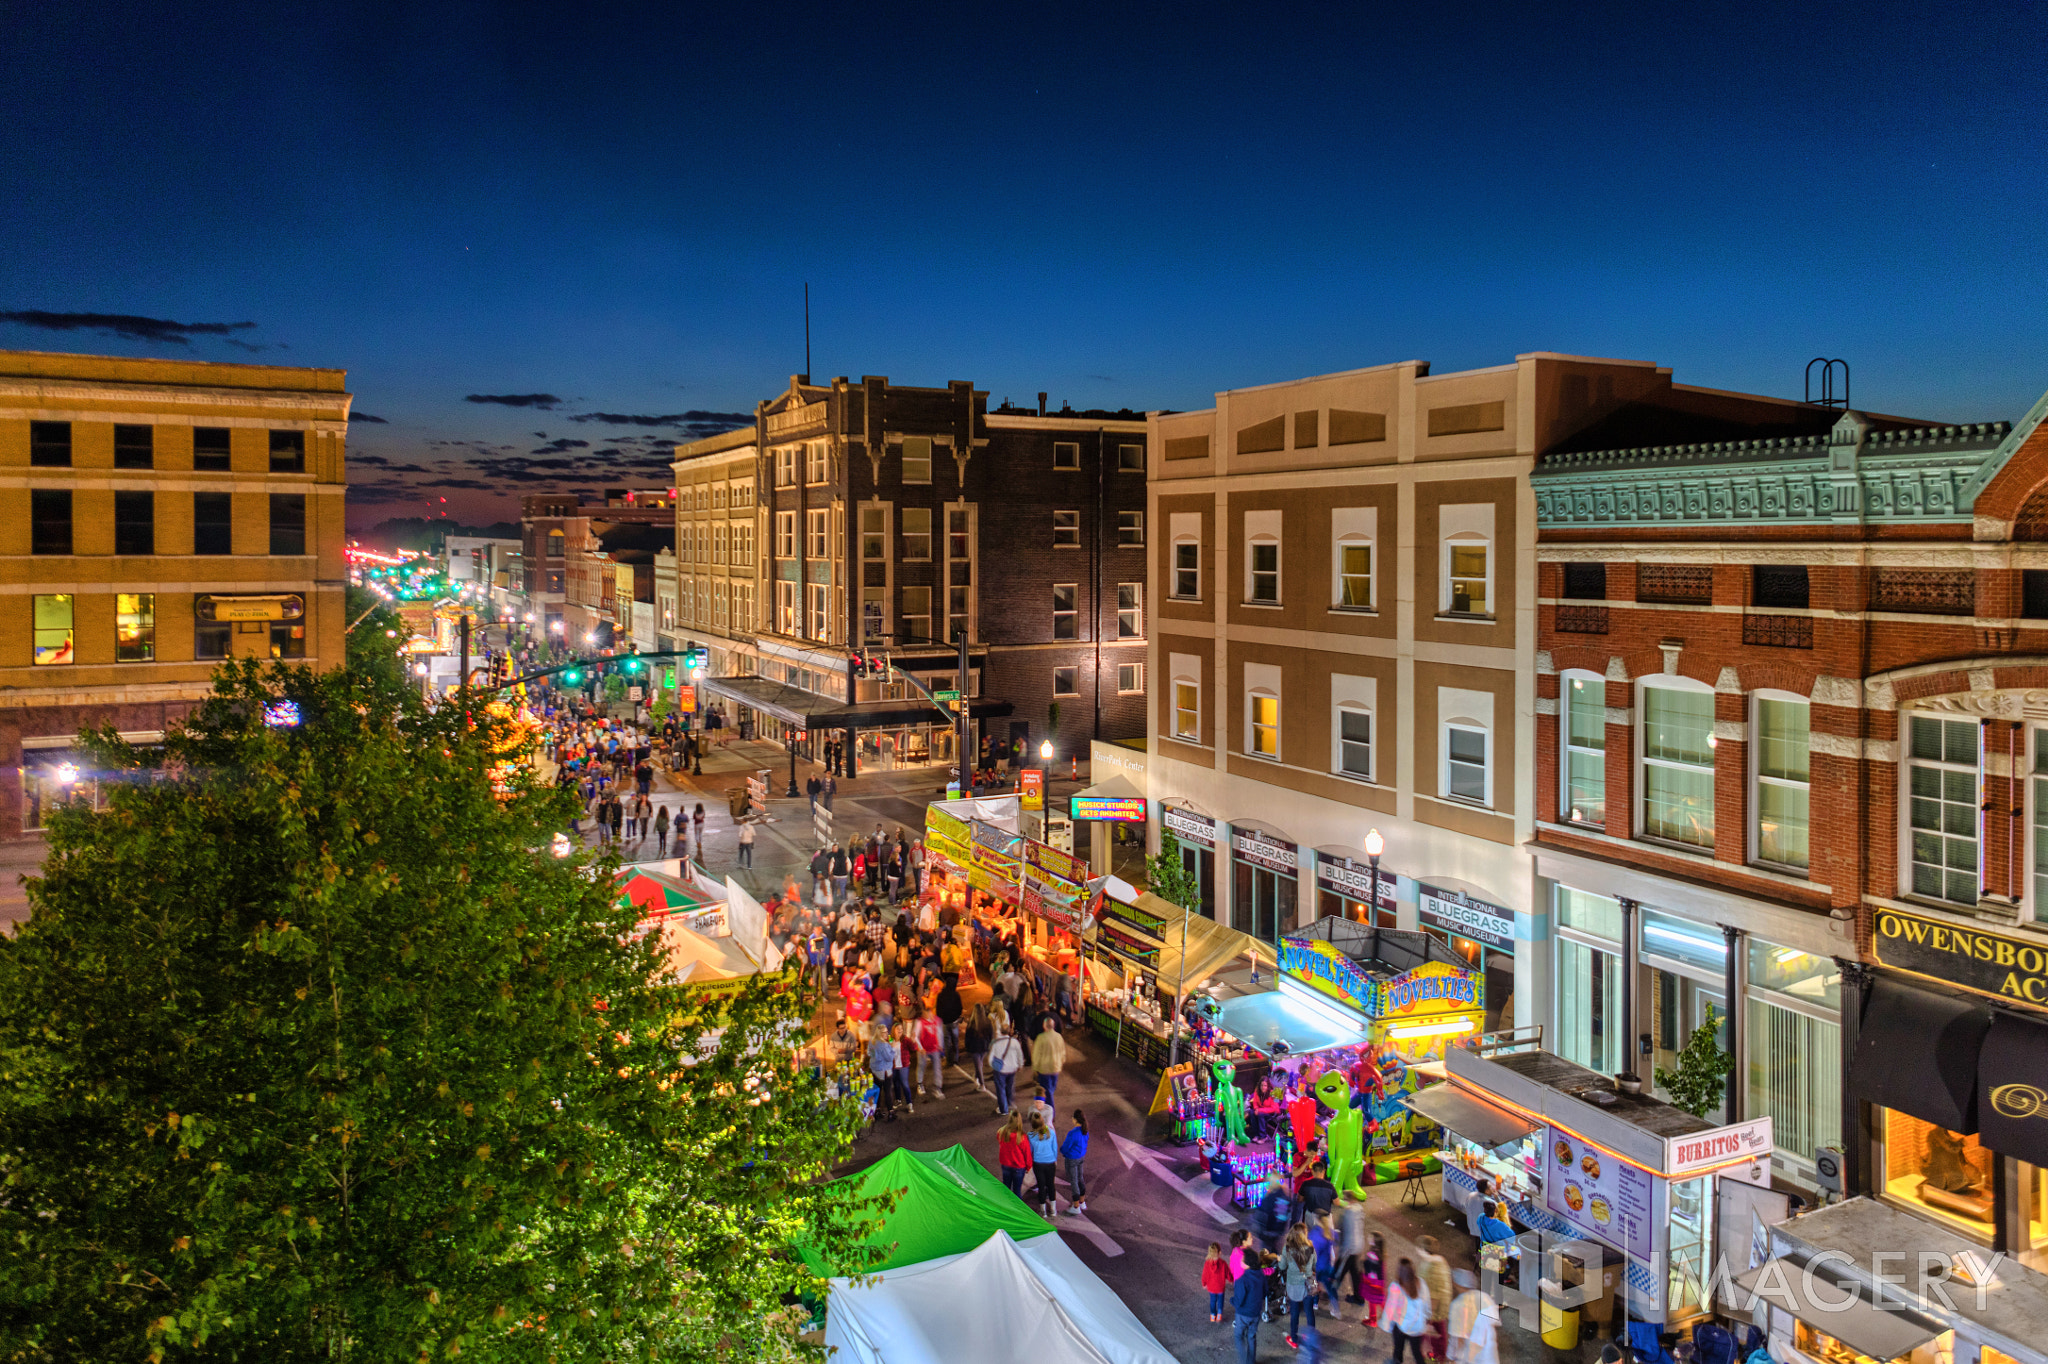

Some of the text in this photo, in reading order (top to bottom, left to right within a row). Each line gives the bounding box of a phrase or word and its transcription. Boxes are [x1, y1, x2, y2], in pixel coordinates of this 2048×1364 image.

[1124, 759, 1144, 772] Center
[1029, 788, 1036, 797] 5
[1078, 800, 1139, 809] MUSICK STUDIOS
[1080, 809, 1136, 818] GETS ANIMATED
[1167, 814, 1215, 839] BLUEGRASS
[1173, 808, 1208, 825] INTERNATIONAL
[1187, 832, 1210, 846] MUSEUM
[1239, 838, 1295, 865] BLUEGRASS
[1244, 853, 1289, 873] MUSIC MUSEUM
[1033, 868, 1050, 882] DEEP
[1332, 882, 1384, 906] MUSIC MUSEM
[1428, 899, 1509, 935] BLUEGRASS
[1437, 917, 1500, 945] MUSIC MUSEUM
[1285, 946, 1371, 1007] NOVELTIES
[695, 982, 736, 992] Delicious
[1387, 976, 1476, 1013] NOVELTIES
[2000, 971, 2048, 1005] AC
[1677, 1133, 1740, 1165] BURRITOS
[1619, 1164, 1636, 1178] Meats
